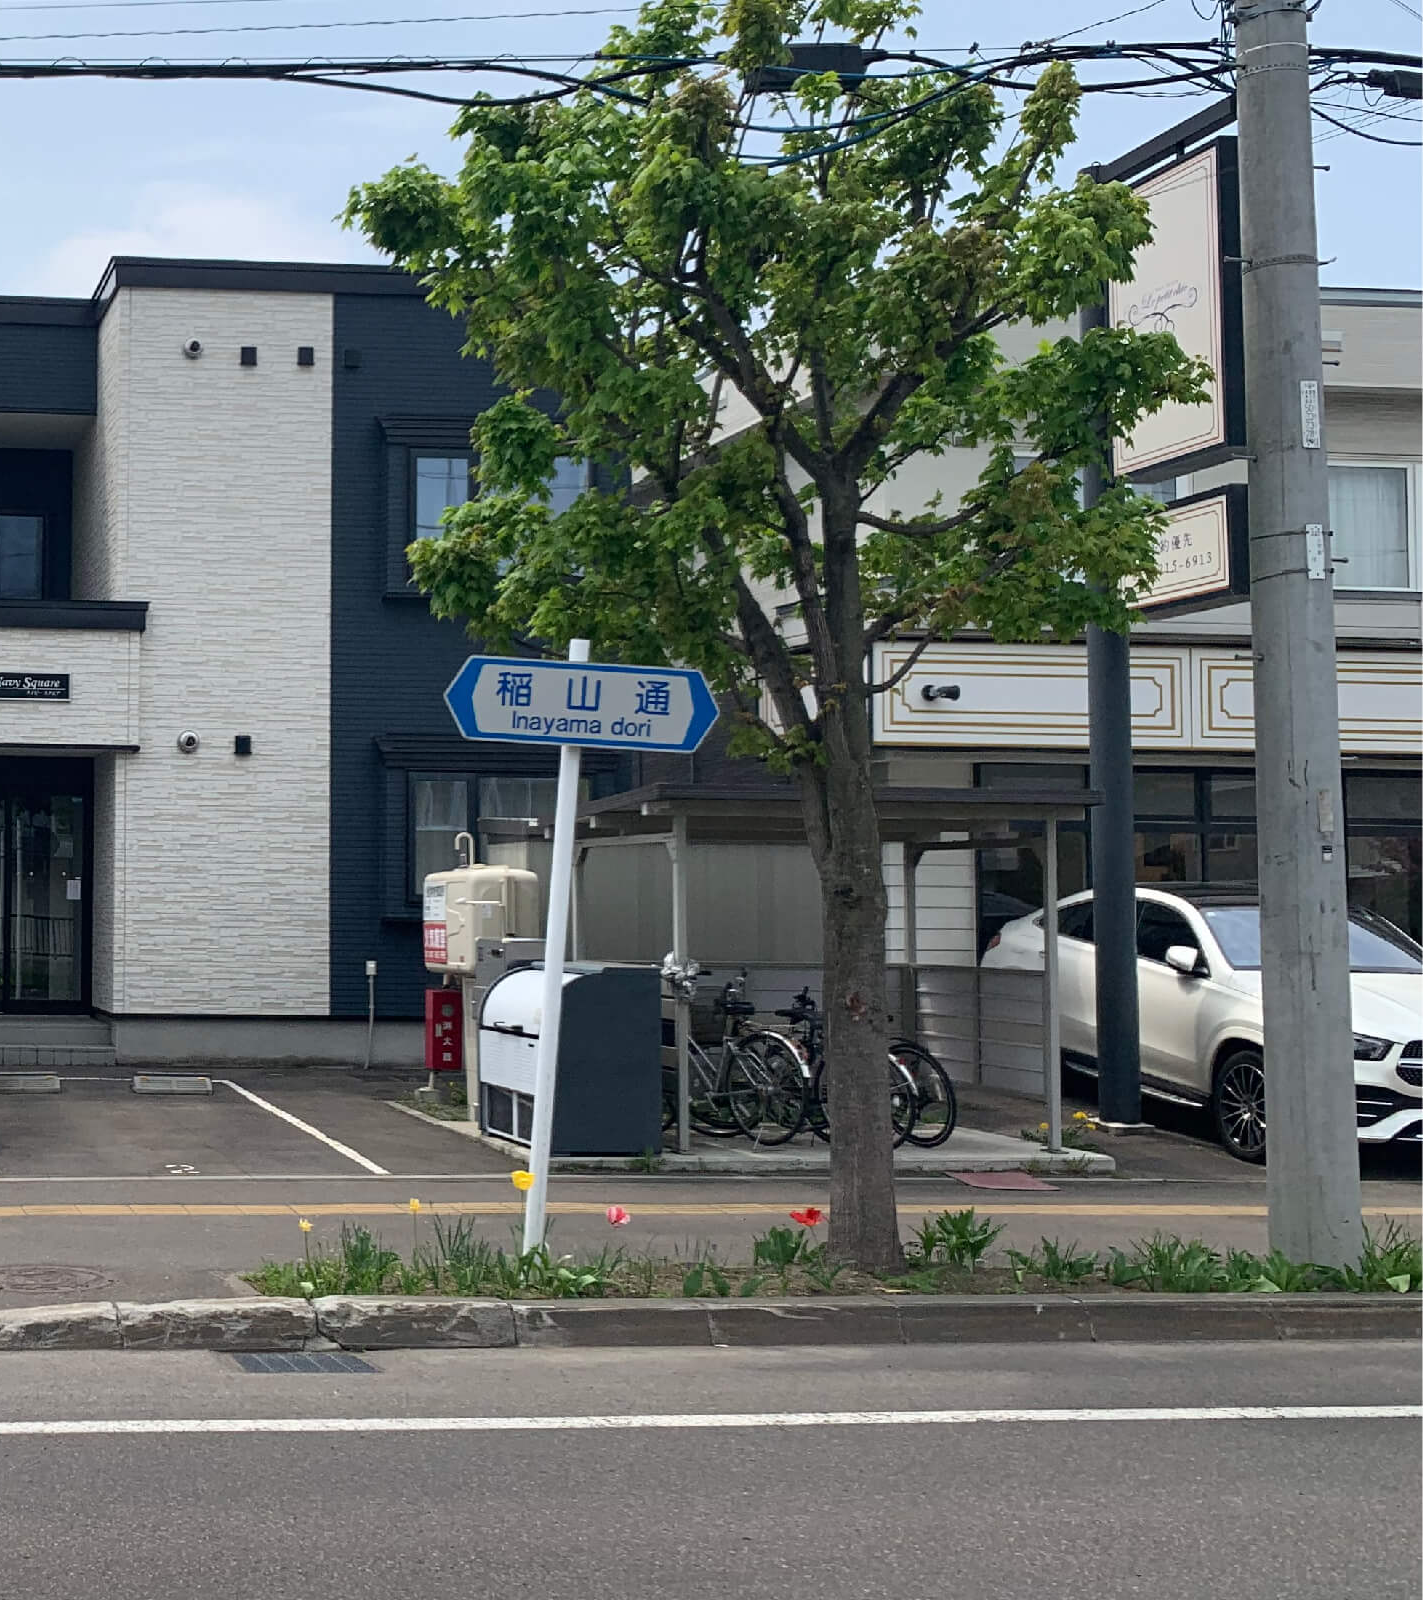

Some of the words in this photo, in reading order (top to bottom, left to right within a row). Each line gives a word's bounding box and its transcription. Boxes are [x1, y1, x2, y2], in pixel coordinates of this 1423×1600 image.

[23, 677, 60, 690] Square
[511, 711, 601, 735] Inayama
[611, 717, 651, 737] dori
